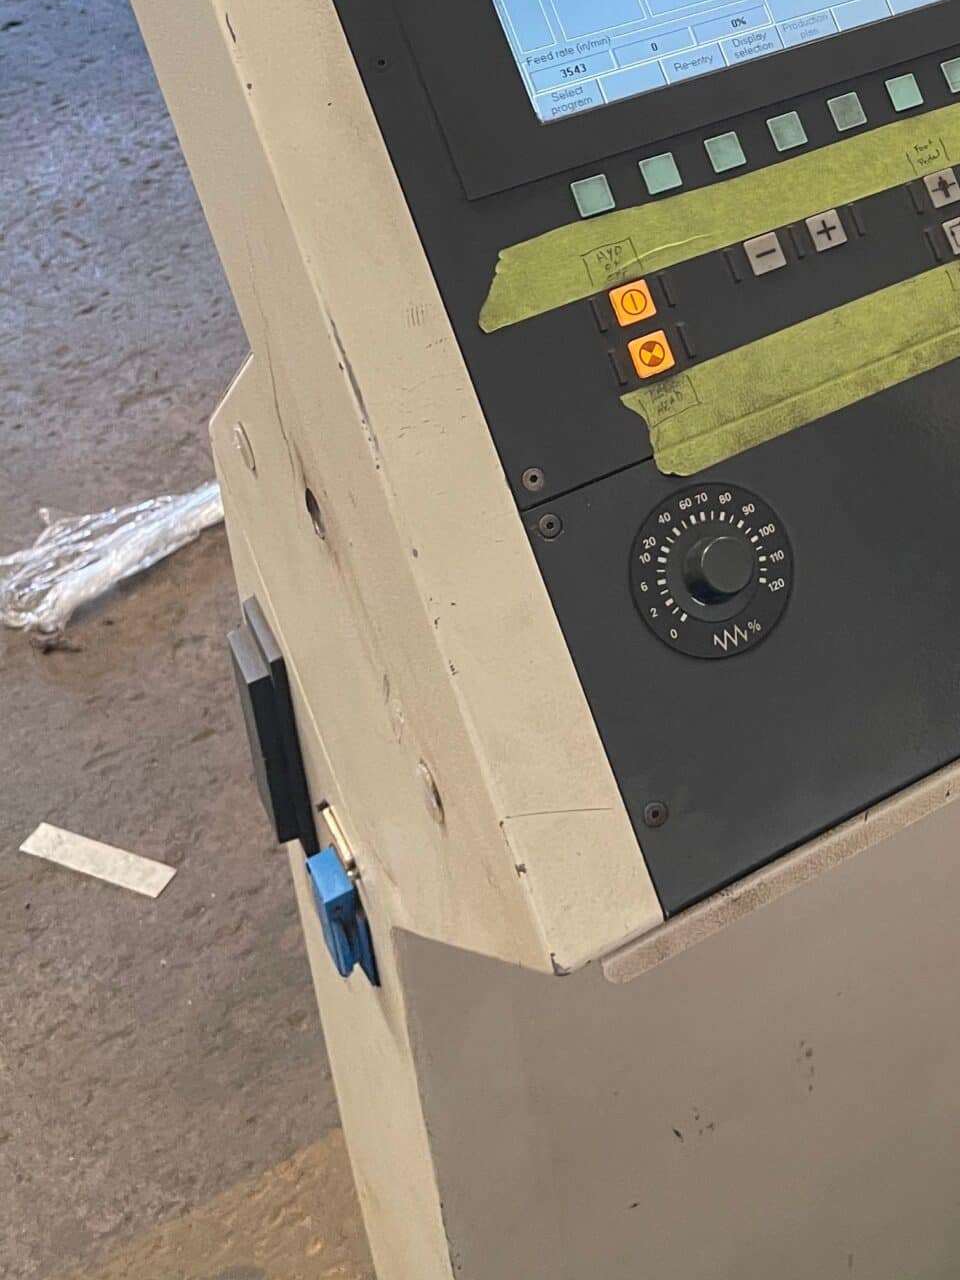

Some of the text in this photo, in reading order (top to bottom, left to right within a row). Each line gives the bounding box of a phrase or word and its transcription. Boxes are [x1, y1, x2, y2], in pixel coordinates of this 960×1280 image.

[730, 15, 747, 28] 0%
[731, 31, 768, 48] Display
[525, 35, 612, 66] Feed rate (in/min)
[650, 42, 659, 53] 0
[734, 41, 775, 59] selection
[673, 53, 714, 73] Re-entry
[559, 62, 587, 79] 3543
[551, 86, 584, 102] Select
[551, 96, 593, 116] program
[678, 497, 693, 511] 60
[694, 491, 709, 505] 70
[718, 491, 732, 505] 80
[741, 503, 756, 516] 90
[658, 511, 672, 525] 40
[758, 523, 776, 538] 100
[642, 536, 657, 550] 20
[639, 552, 651, 564] 10
[769, 549, 785, 564] 110
[640, 582, 649, 592] 6
[767, 577, 785, 593] 120
[650, 608, 658, 618] 2
[670, 629, 678, 639] 0
